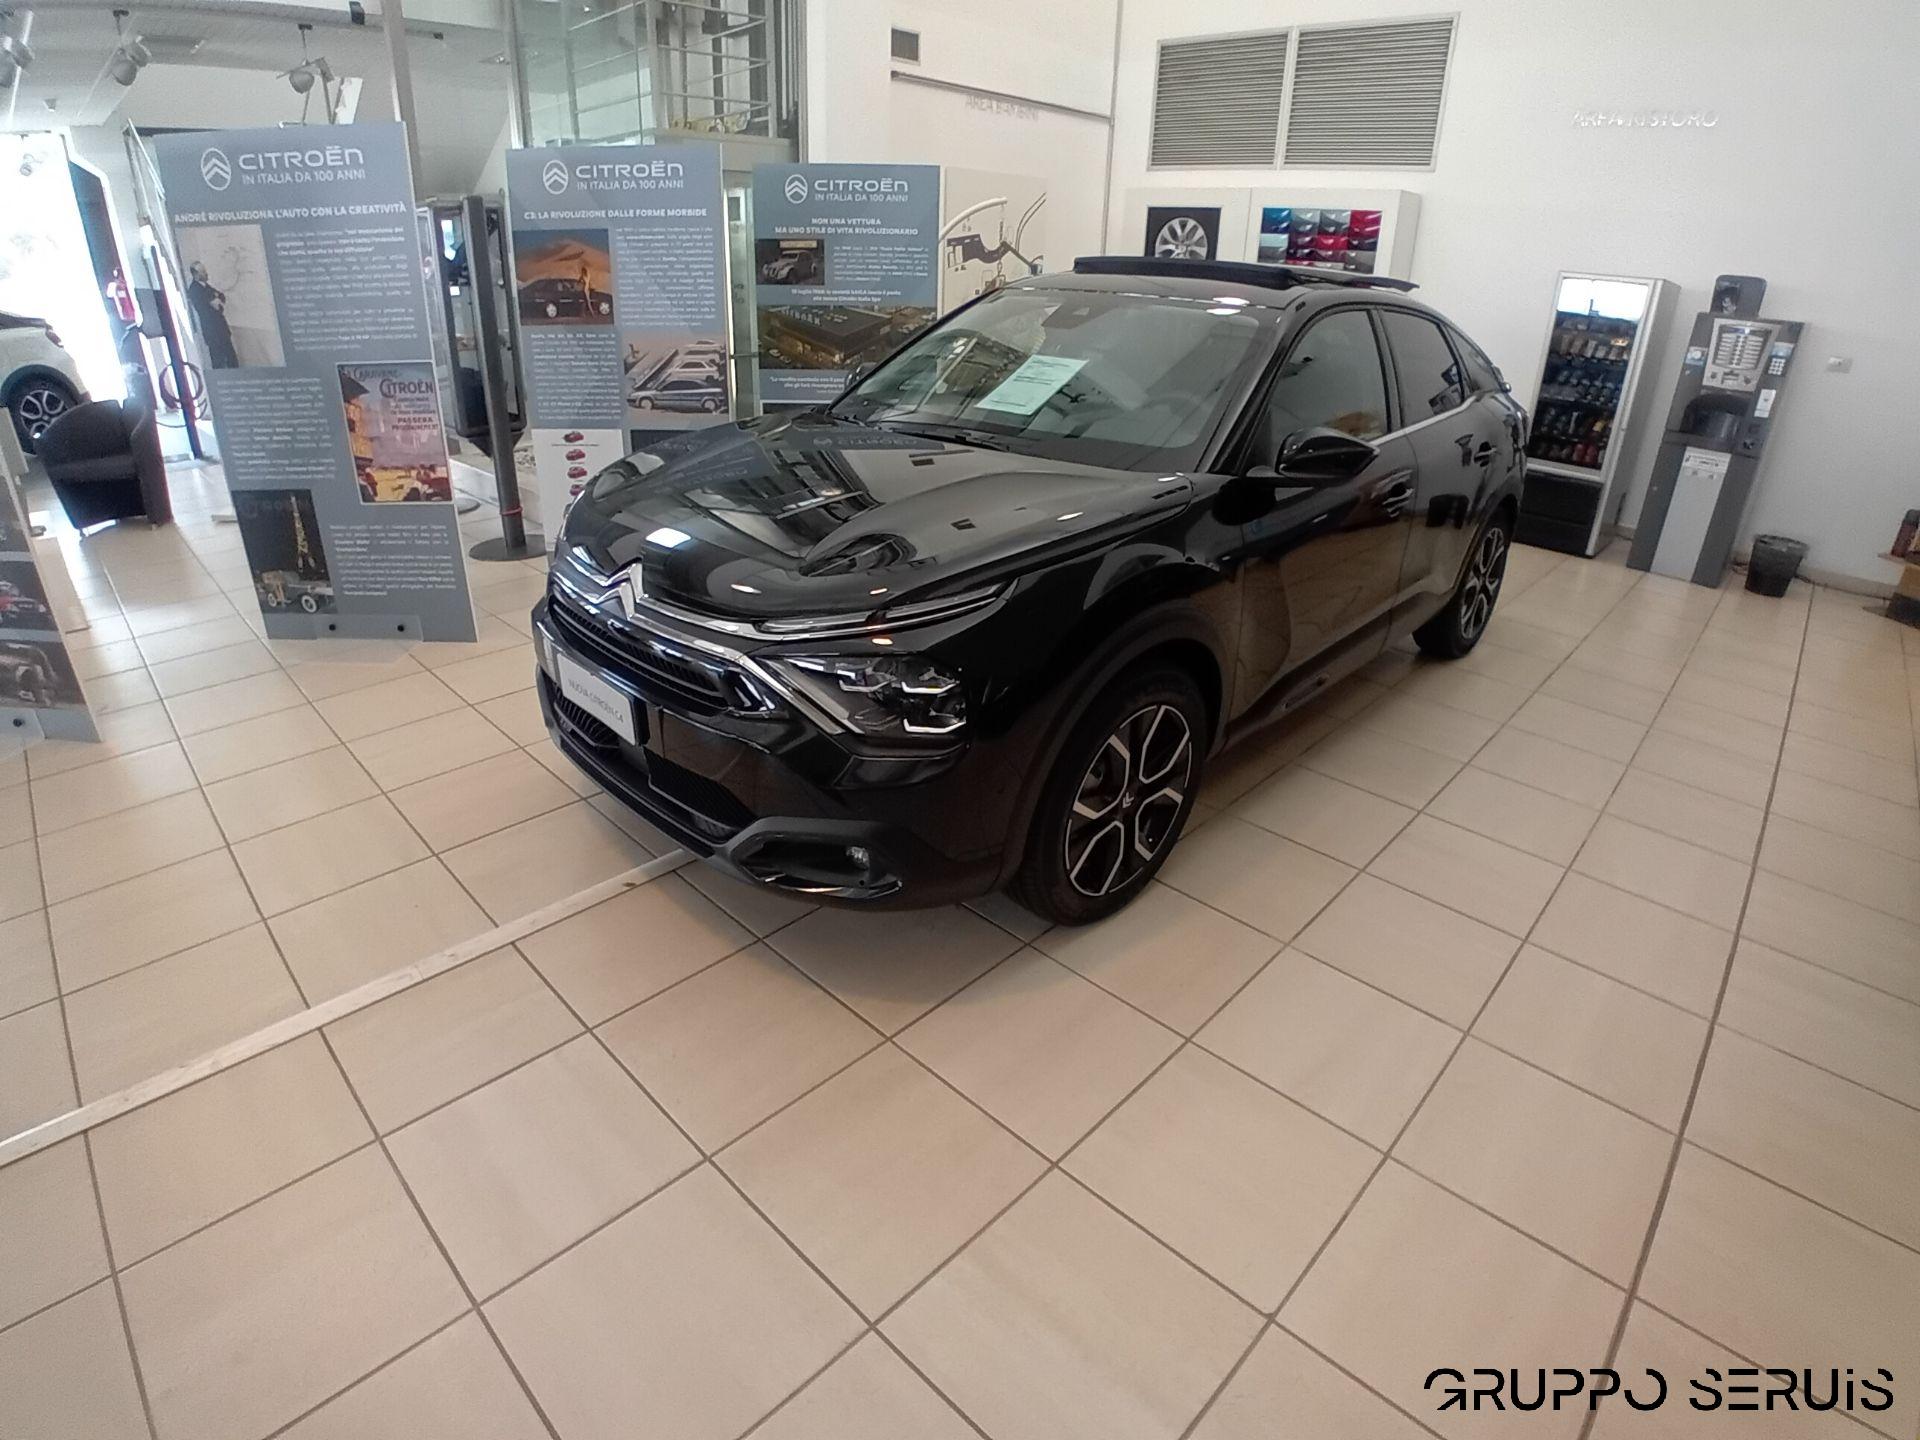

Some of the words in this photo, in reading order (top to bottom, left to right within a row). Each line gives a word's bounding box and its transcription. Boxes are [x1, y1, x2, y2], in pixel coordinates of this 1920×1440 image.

[242, 174, 255, 185] IN
[257, 173, 292, 185] ITALIA
[295, 171, 312, 183] DA
[314, 170, 334, 182] 100
[336, 168, 366, 181] ANNI
[577, 181, 588, 191] IN
[590, 180, 621, 191] ITALIA
[623, 180, 637, 190] DA
[639, 179, 656, 190] 100
[658, 179, 684, 189] ANNI
[815, 193, 824, 202] IN
[826, 193, 853, 202] ITALIA
[854, 193, 867, 202] DA
[869, 193, 884, 203] 100
[885, 193, 909, 203] ANNI
[208, 209, 274, 222] RIVOLUZIONA
[310, 207, 332, 218] CON
[334, 205, 347, 217] LA
[349, 201, 407, 215] CREATIVITÀ
[538, 210, 549, 220] LA
[551, 209, 606, 219] RIVOLUZIONE
[607, 209, 634, 218] DALLE
[636, 208, 665, 218] FORME
[667, 208, 707, 217] MORBIDE
[811, 217, 828, 225] NON
[847, 218, 881, 226] VETTURA
[836, 227, 853, 235] VITA
[855, 227, 919, 236] RIVOLUZIONARIO
